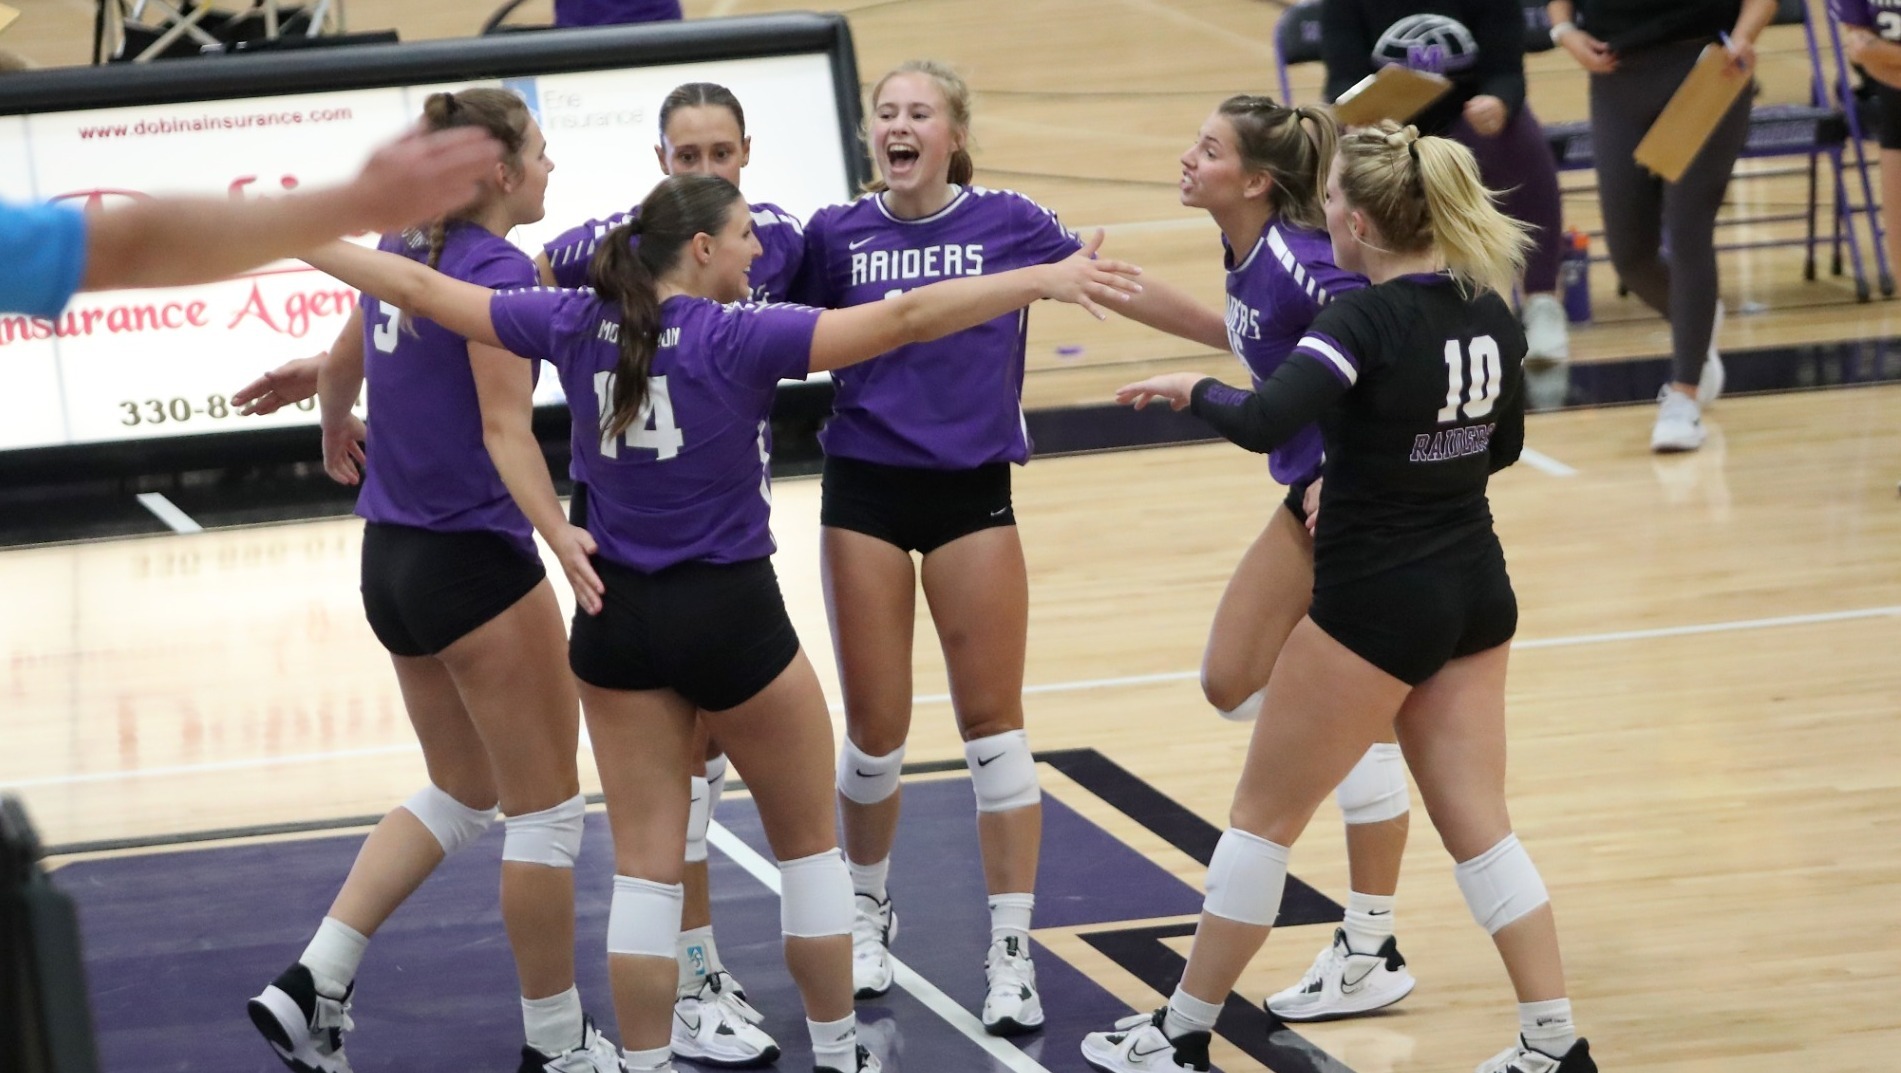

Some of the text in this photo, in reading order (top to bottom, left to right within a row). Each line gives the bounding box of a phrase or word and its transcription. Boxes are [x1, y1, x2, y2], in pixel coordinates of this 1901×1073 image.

[78, 106, 353, 140] www.dobinainsurance.com
[852, 244, 983, 286] RAIDERS
[228, 278, 358, 339] Agen
[1437, 334, 1502, 423] 10
[593, 370, 684, 461] 14
